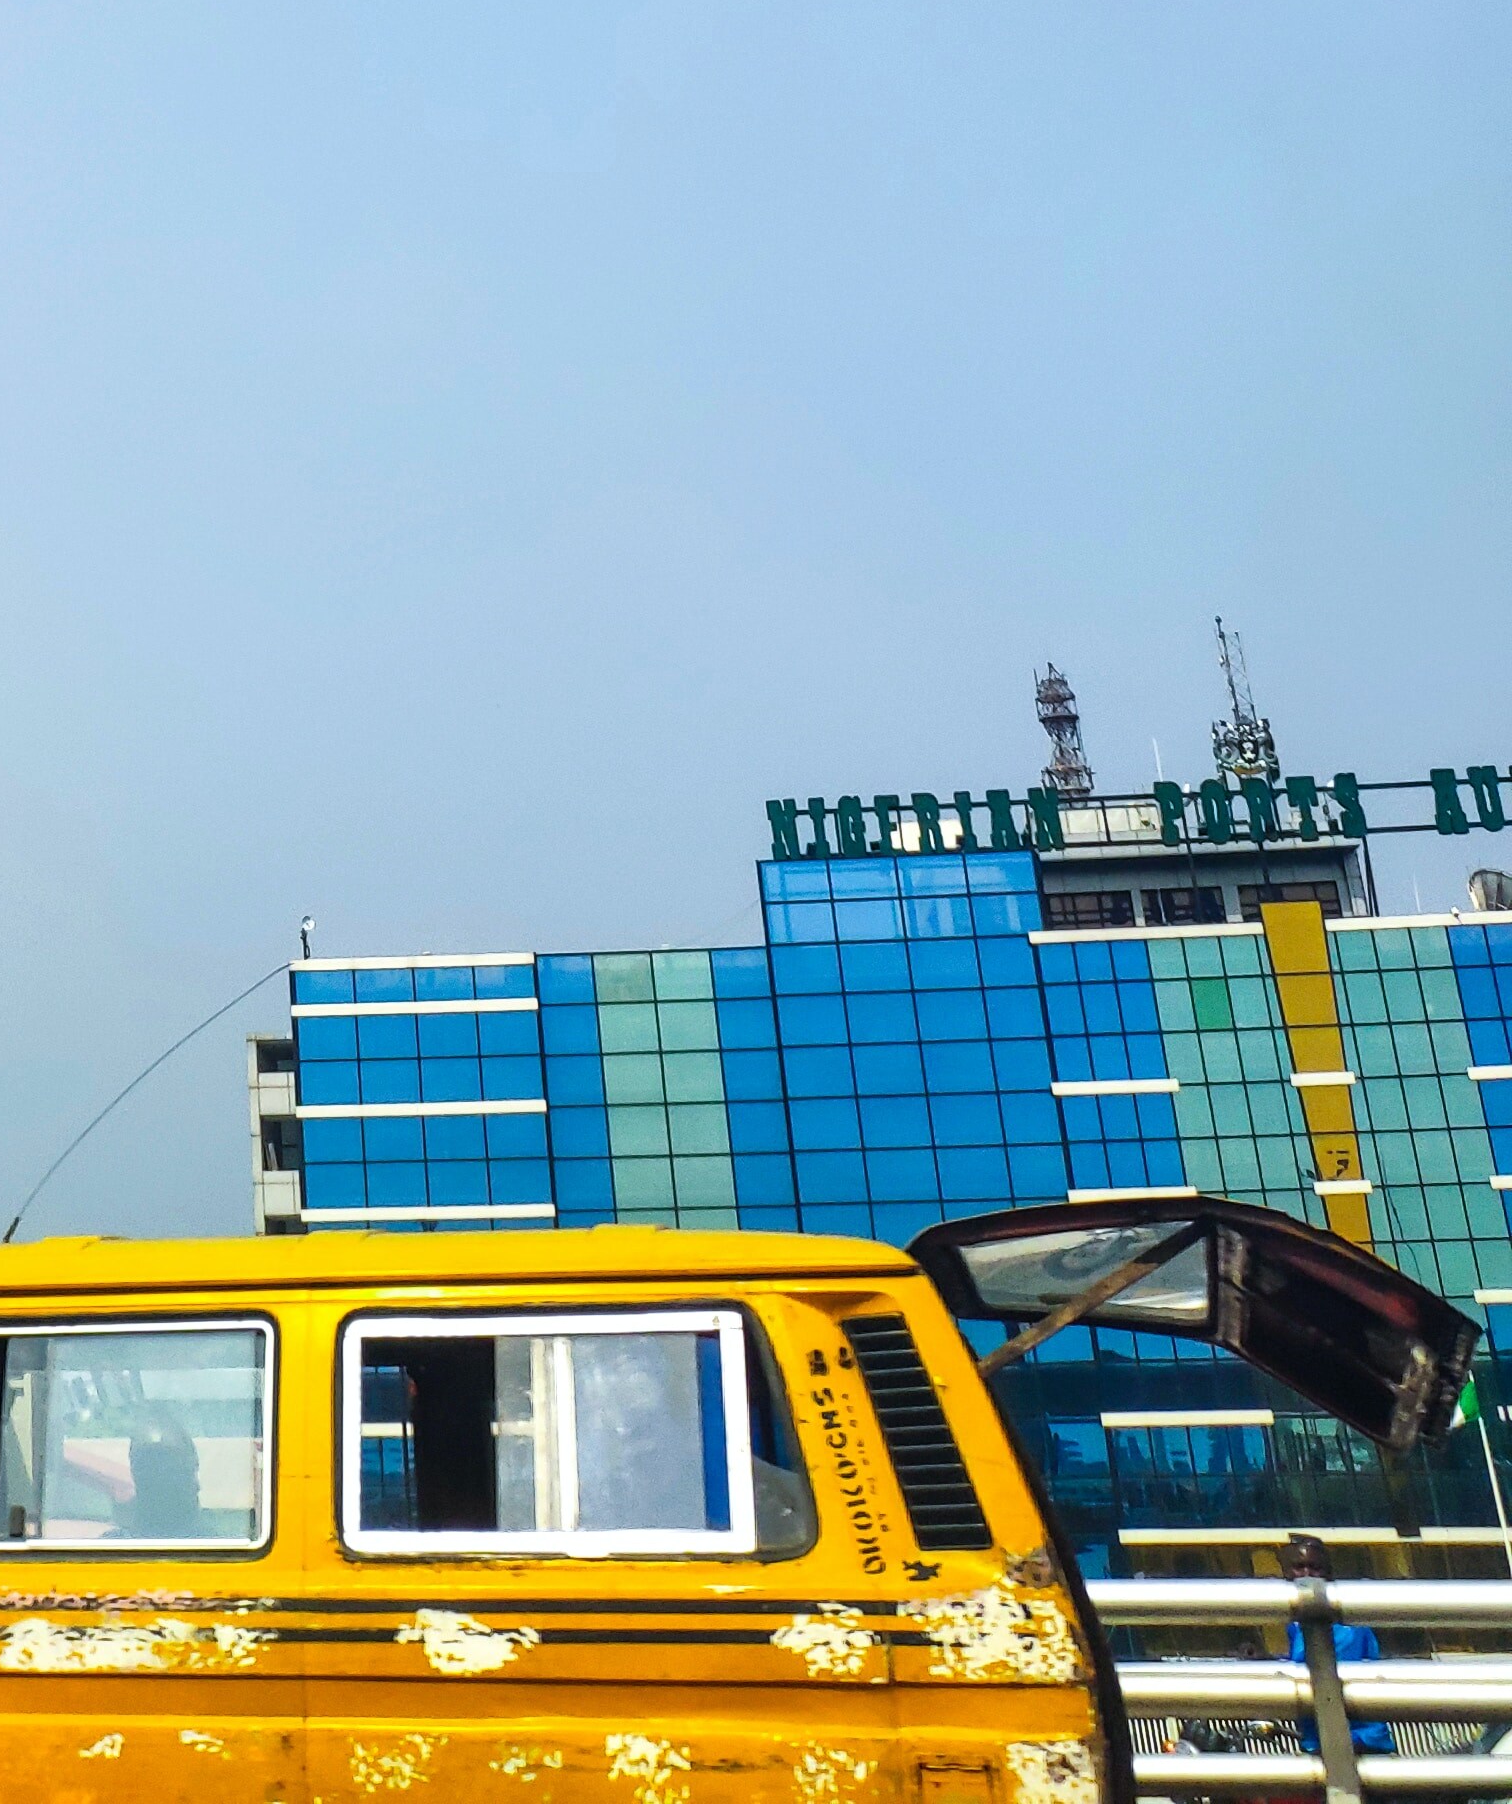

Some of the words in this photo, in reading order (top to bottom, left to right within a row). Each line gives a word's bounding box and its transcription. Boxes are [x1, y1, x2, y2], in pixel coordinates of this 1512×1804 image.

[765, 787, 1066, 860] NIGERIAN
[1153, 772, 1368, 847] PORTS
[1430, 765, 1512, 835] AU
